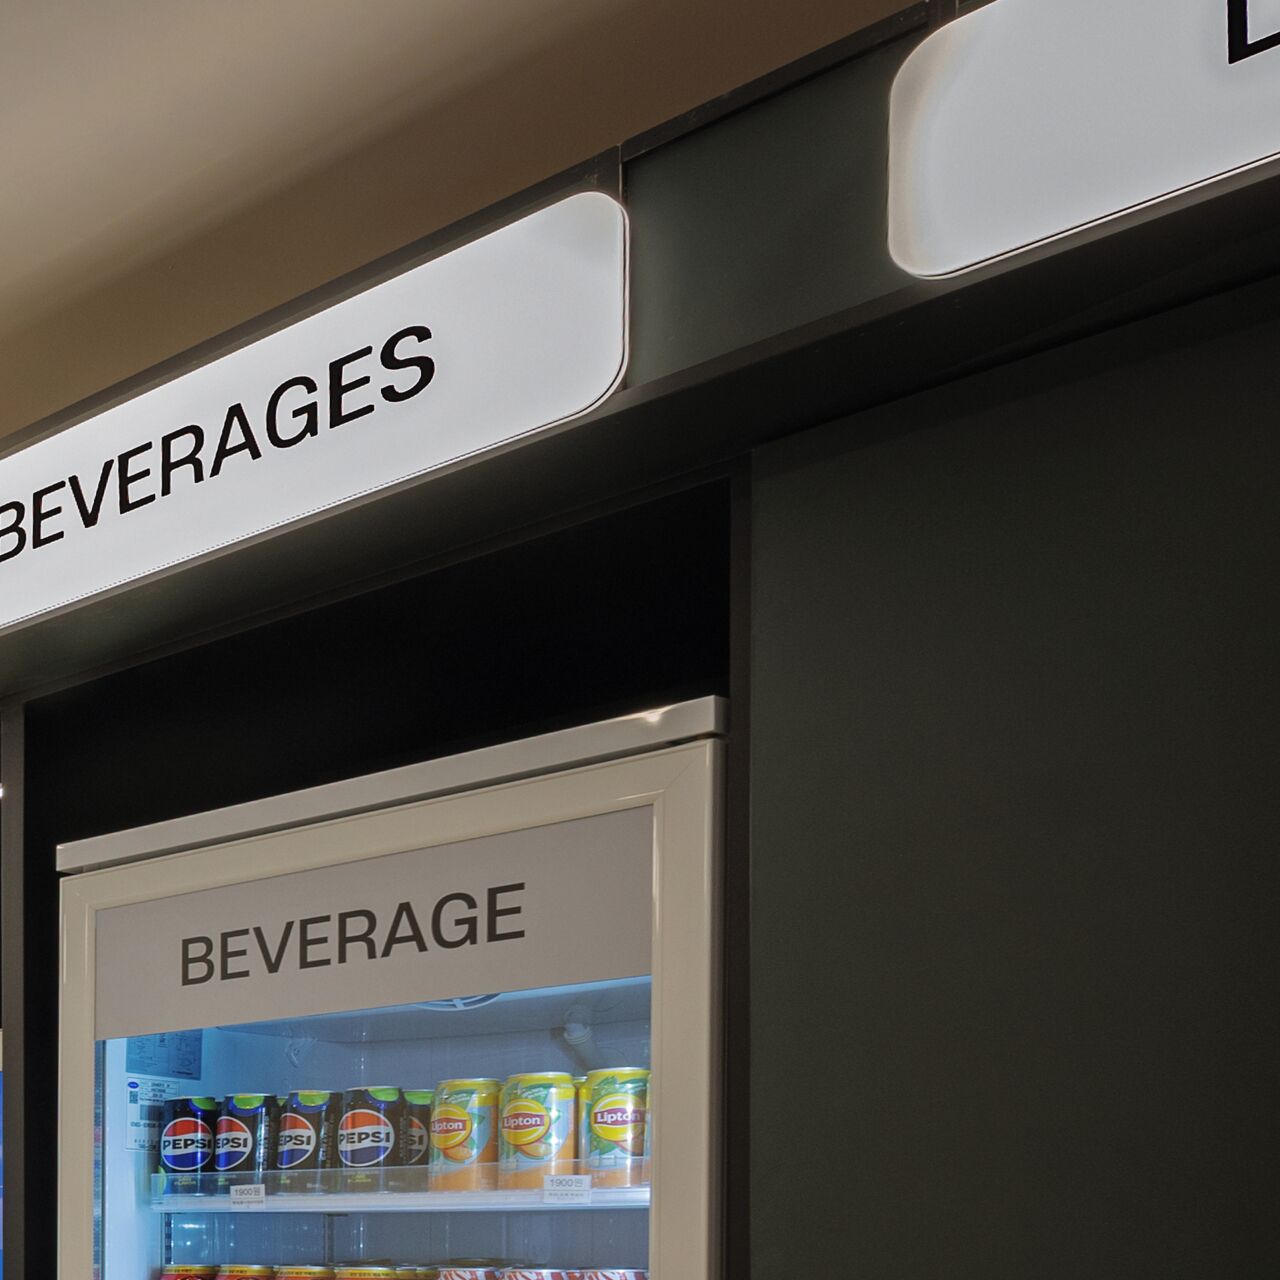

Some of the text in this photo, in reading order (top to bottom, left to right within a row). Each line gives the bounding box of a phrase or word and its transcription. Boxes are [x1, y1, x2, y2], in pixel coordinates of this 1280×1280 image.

[181, 882, 526, 987] BEVERAGE
[503, 1116, 541, 1129] Lipton
[596, 1110, 640, 1124] Lipton
[162, 1138, 213, 1151] PEPSI
[216, 1137, 248, 1149] EPSI
[279, 1134, 312, 1146] EPSI
